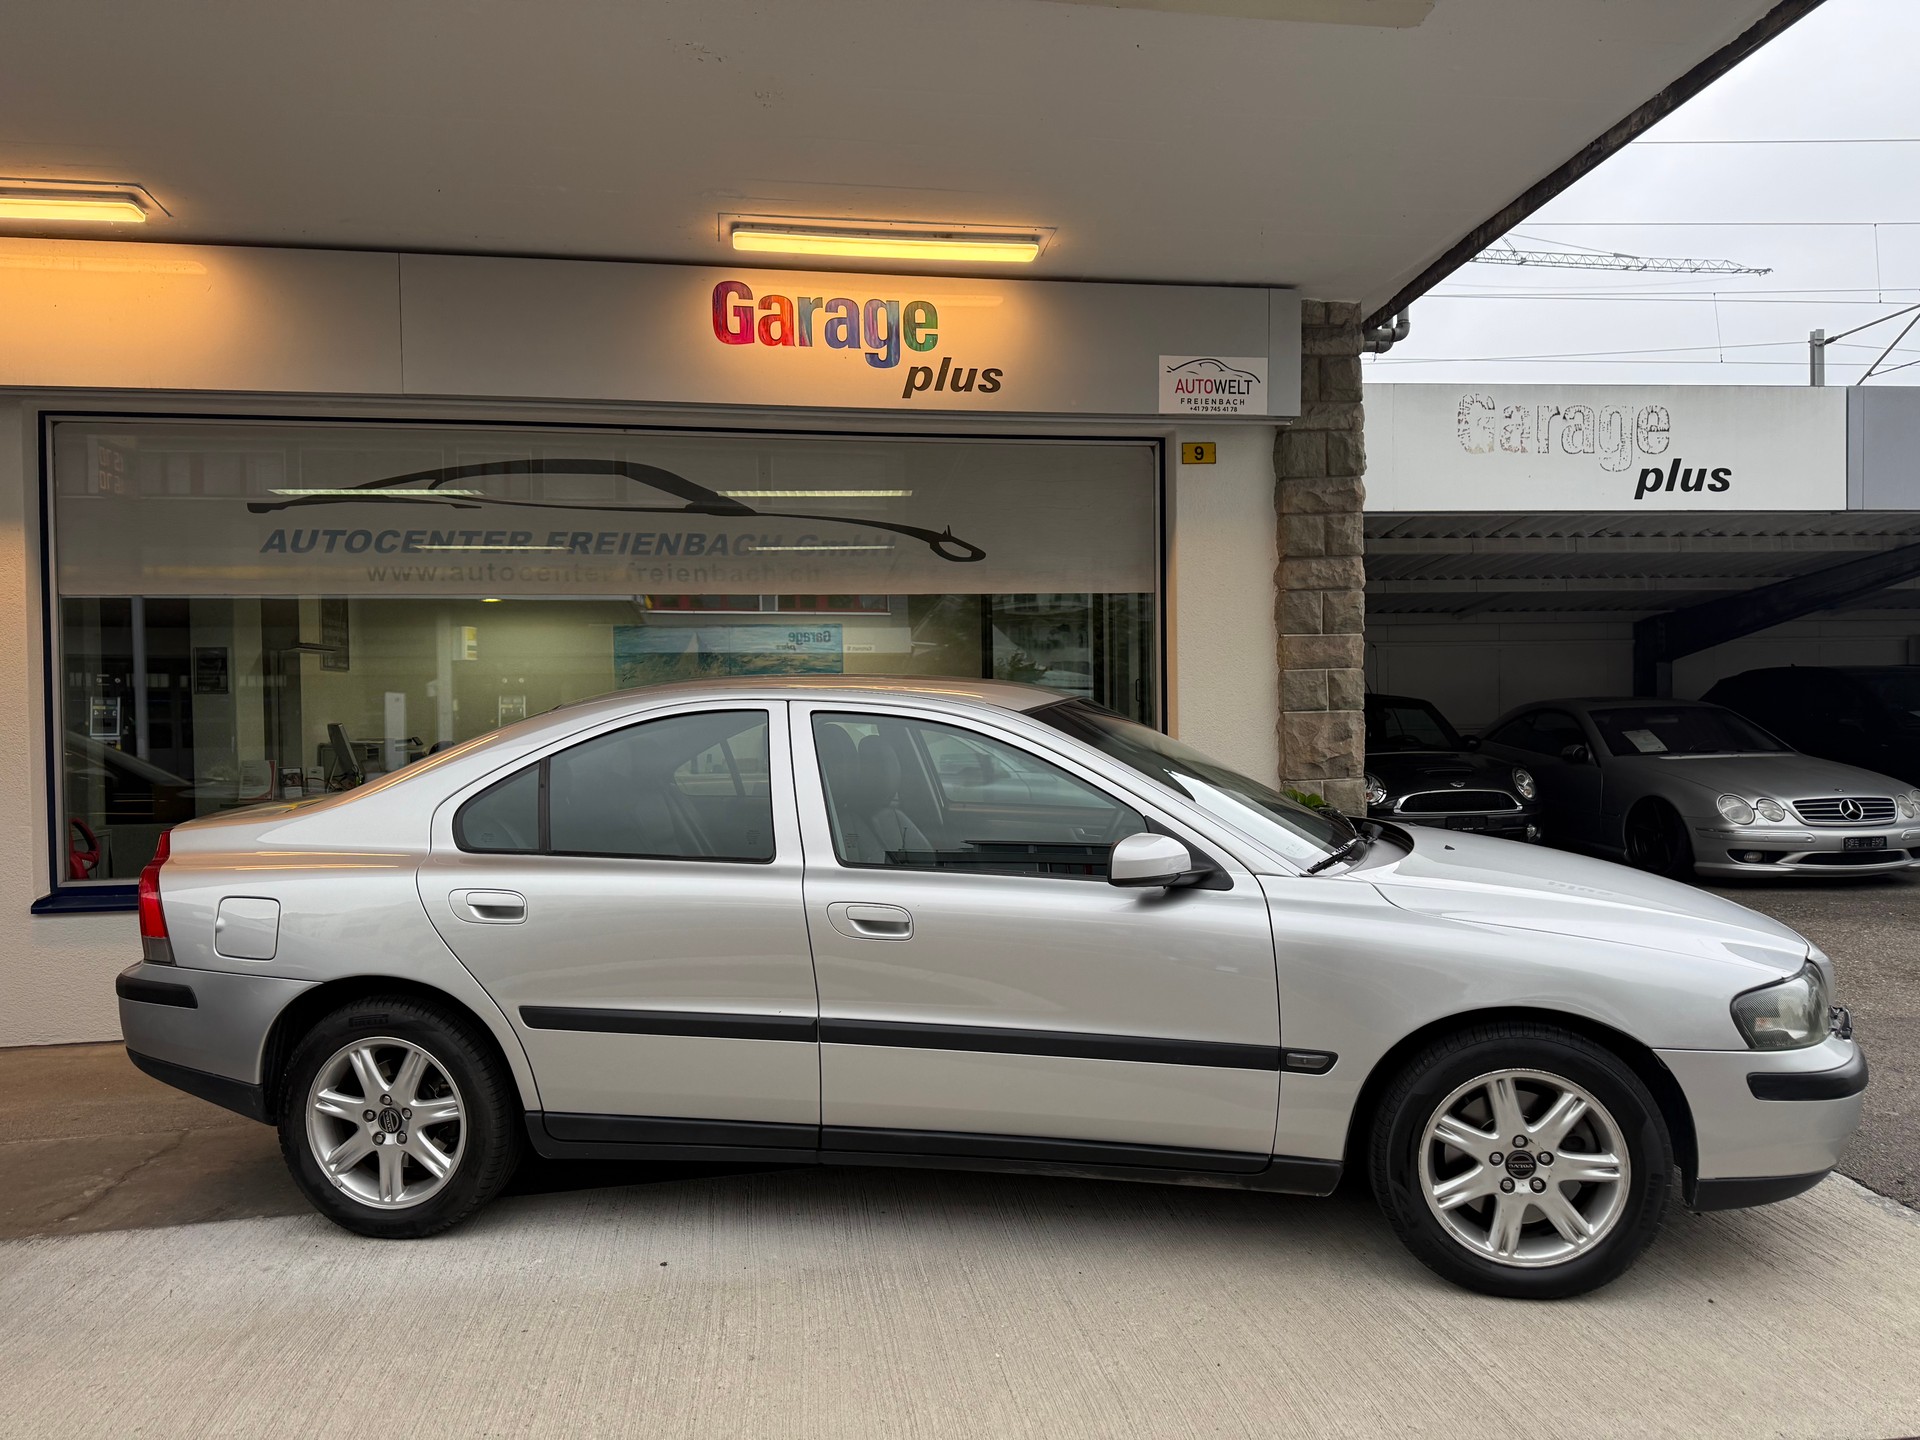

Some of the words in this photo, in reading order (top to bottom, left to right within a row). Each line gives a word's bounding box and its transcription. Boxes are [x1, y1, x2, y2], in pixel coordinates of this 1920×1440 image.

[711, 280, 940, 368] Garage
[902, 358, 1004, 399] plus
[1174, 378, 1253, 395] AUTOWELT
[1457, 392, 1671, 473] Garage
[1194, 446, 1205, 461] 9
[1634, 458, 1733, 500] plus
[259, 529, 533, 555] AUTOCENTER
[543, 531, 784, 557] FREIENBACH
[794, 533, 897, 558] GmbH
